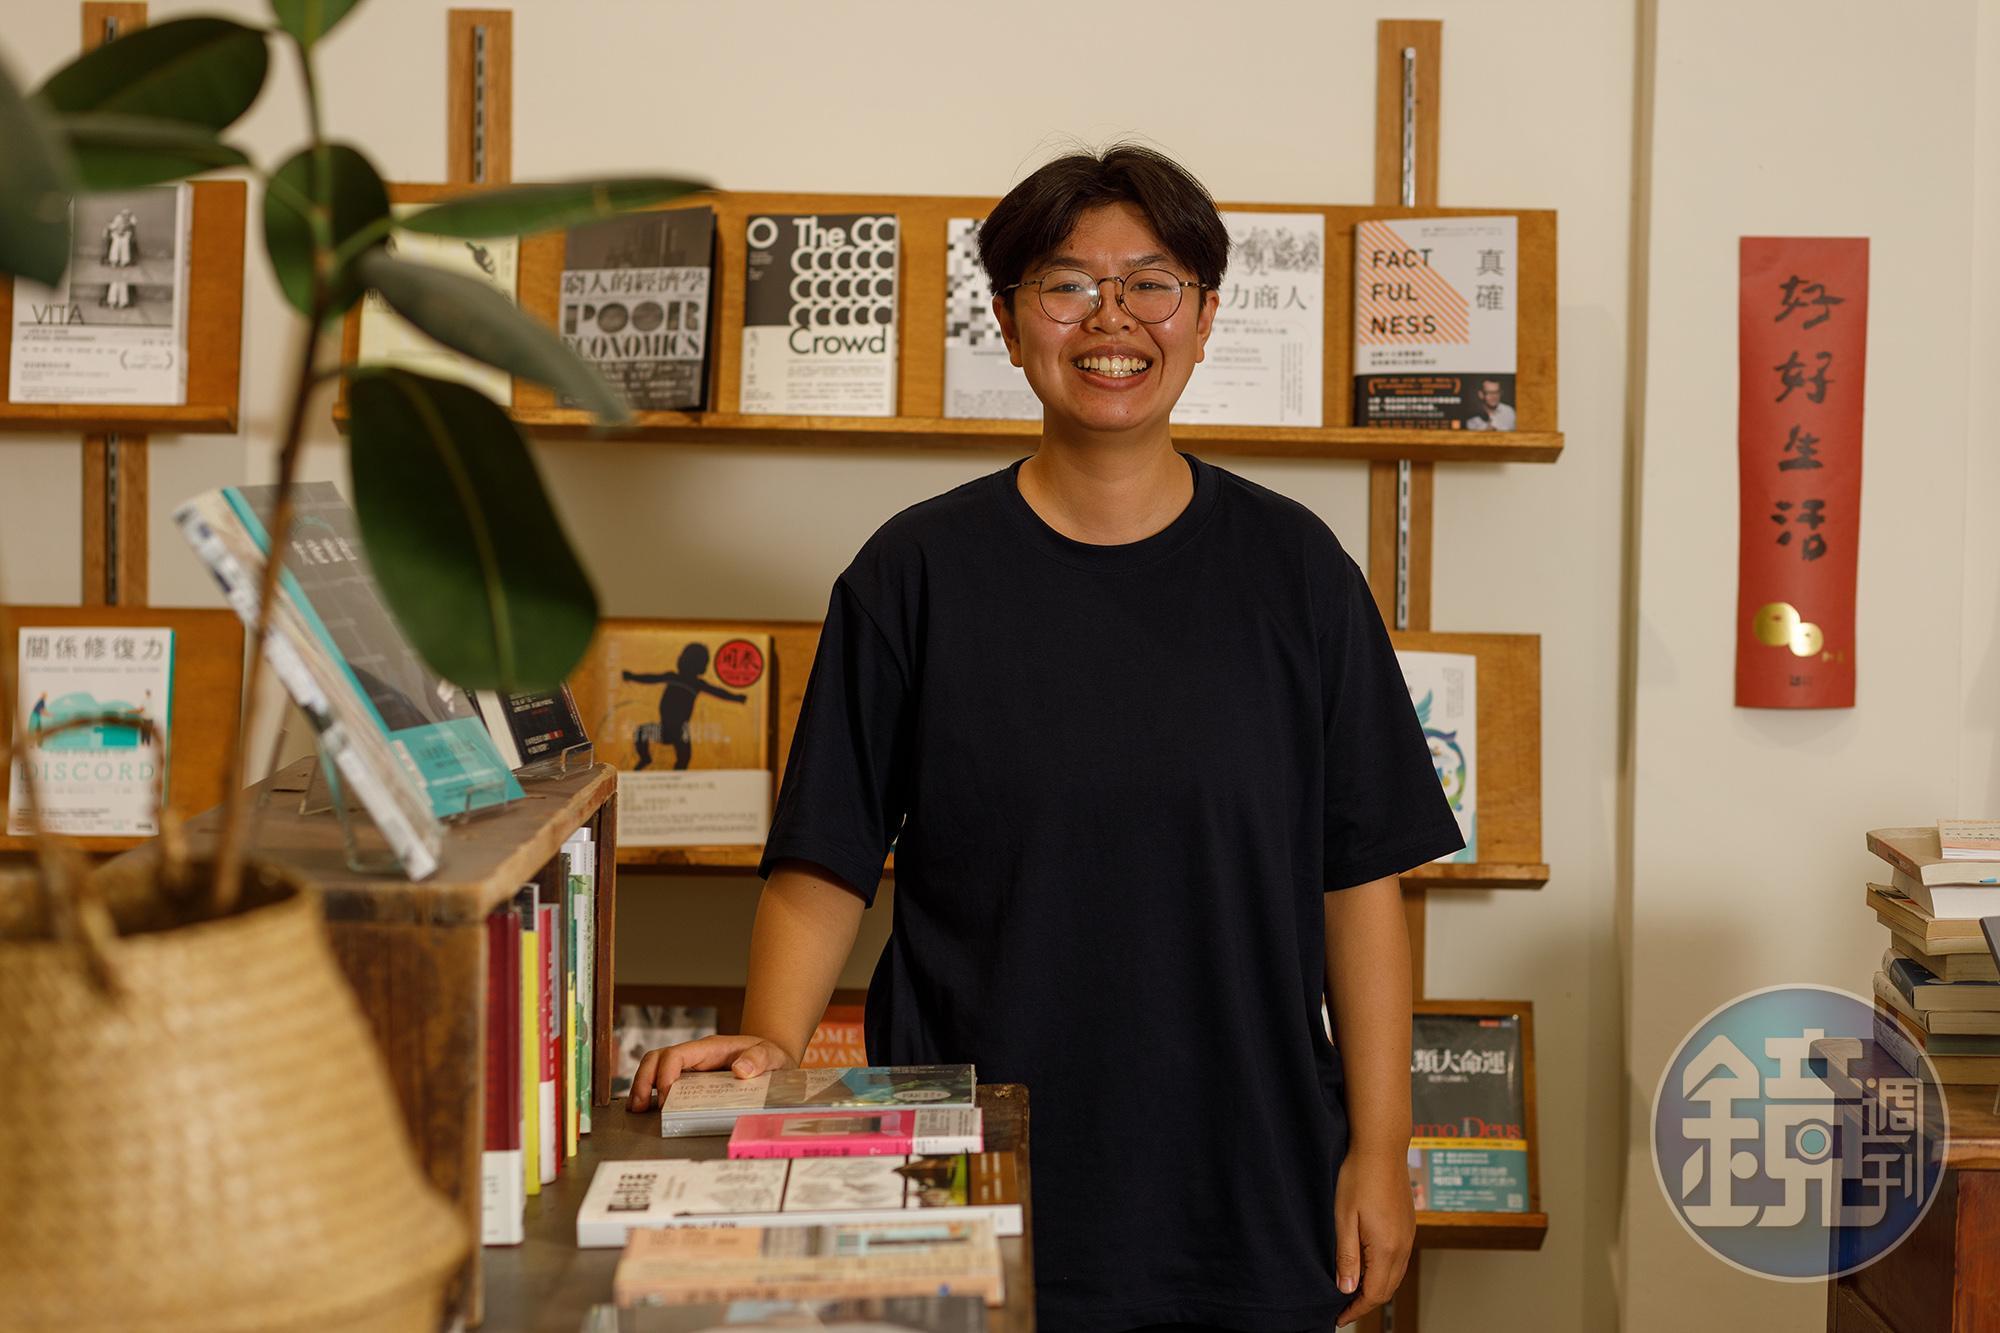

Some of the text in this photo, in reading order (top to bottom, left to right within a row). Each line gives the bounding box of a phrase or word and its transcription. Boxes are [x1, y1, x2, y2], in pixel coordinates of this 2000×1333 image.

[792, 216, 846, 247] The
[1372, 248, 1433, 269] FACT
[1476, 249, 1505, 310] 真確
[1228, 282, 1308, 311] 力商人
[1372, 283, 1419, 302] FUL
[1371, 315, 1437, 335] NESS
[789, 327, 887, 354] Crowd
[1770, 275, 1845, 560] 好好生活
[25, 635, 164, 660] 關係修復力
[813, 1027, 858, 1044] OME
[804, 1047, 864, 1064] OVAN
[1411, 1048, 1506, 1075] 類大命運
[1460, 1115, 1521, 1139] Deus
